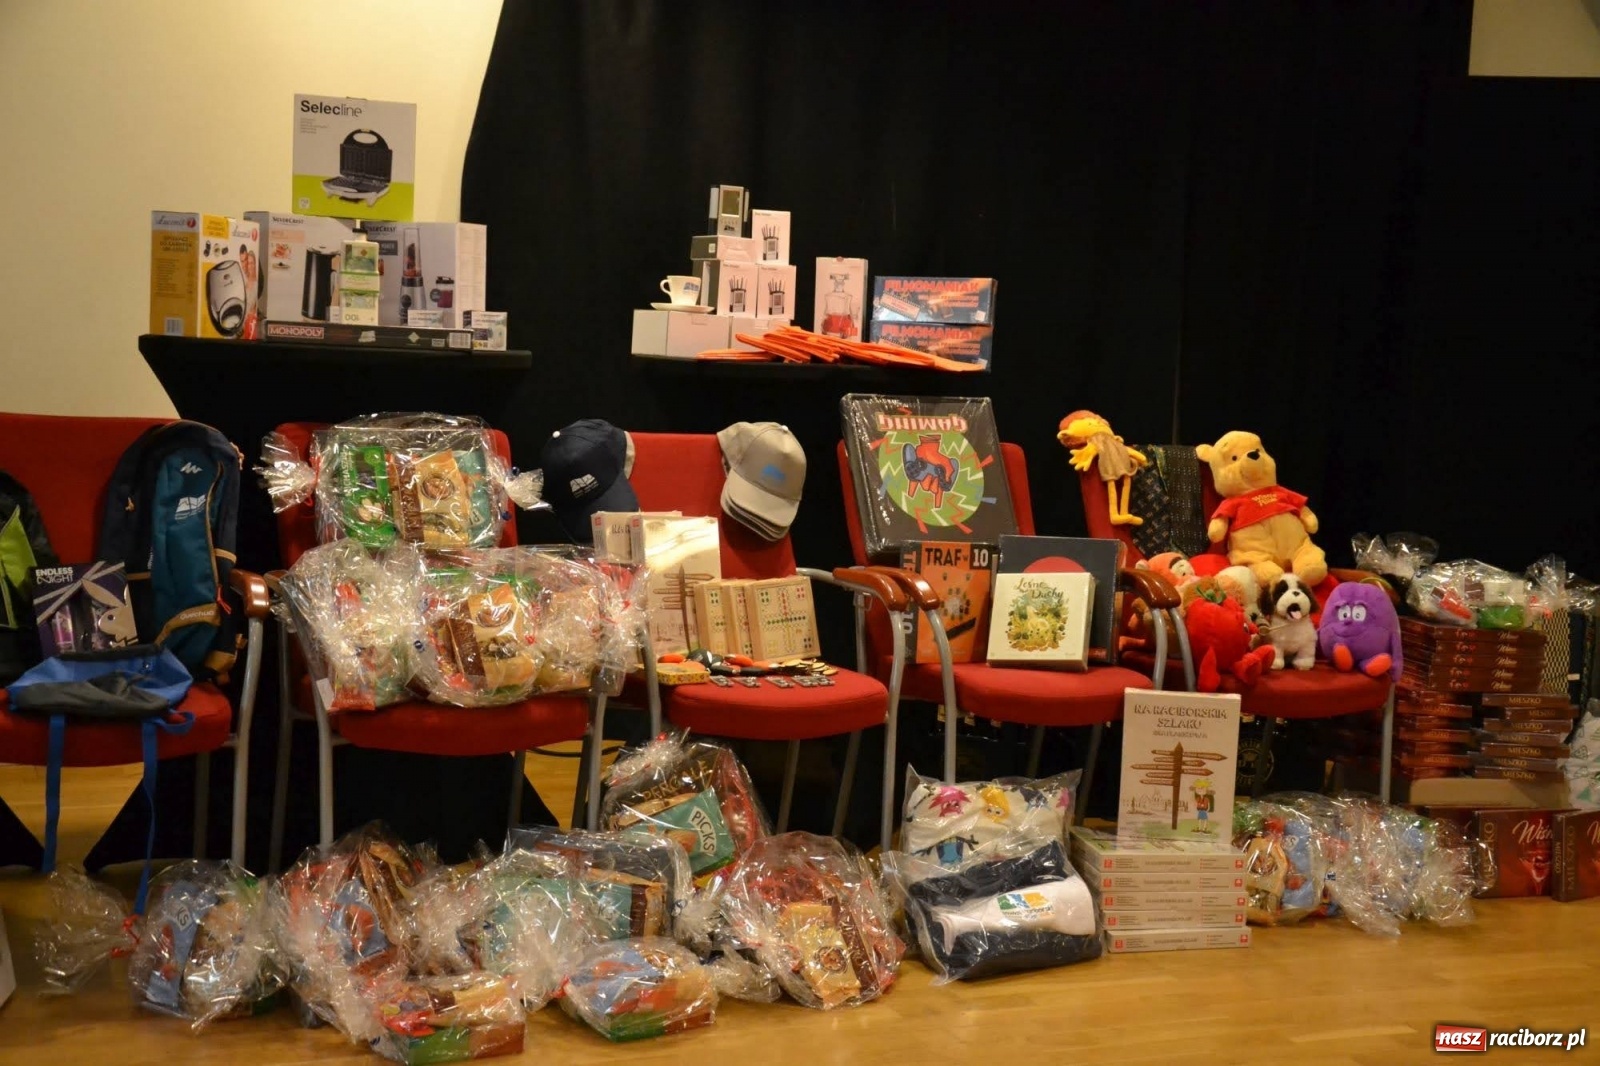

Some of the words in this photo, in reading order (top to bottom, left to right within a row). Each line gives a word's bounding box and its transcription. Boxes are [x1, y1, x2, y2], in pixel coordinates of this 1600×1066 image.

[300, 100, 362, 117] Selecline
[269, 327, 322, 337] MONOPOLY
[877, 413, 968, 432] GAMING
[925, 547, 962, 566] TRAF
[973, 548, 989, 567] 10
[35, 567, 74, 577] ENDLESS
[36, 574, 74, 585] NIGHT
[692, 810, 715, 853] PICKS
